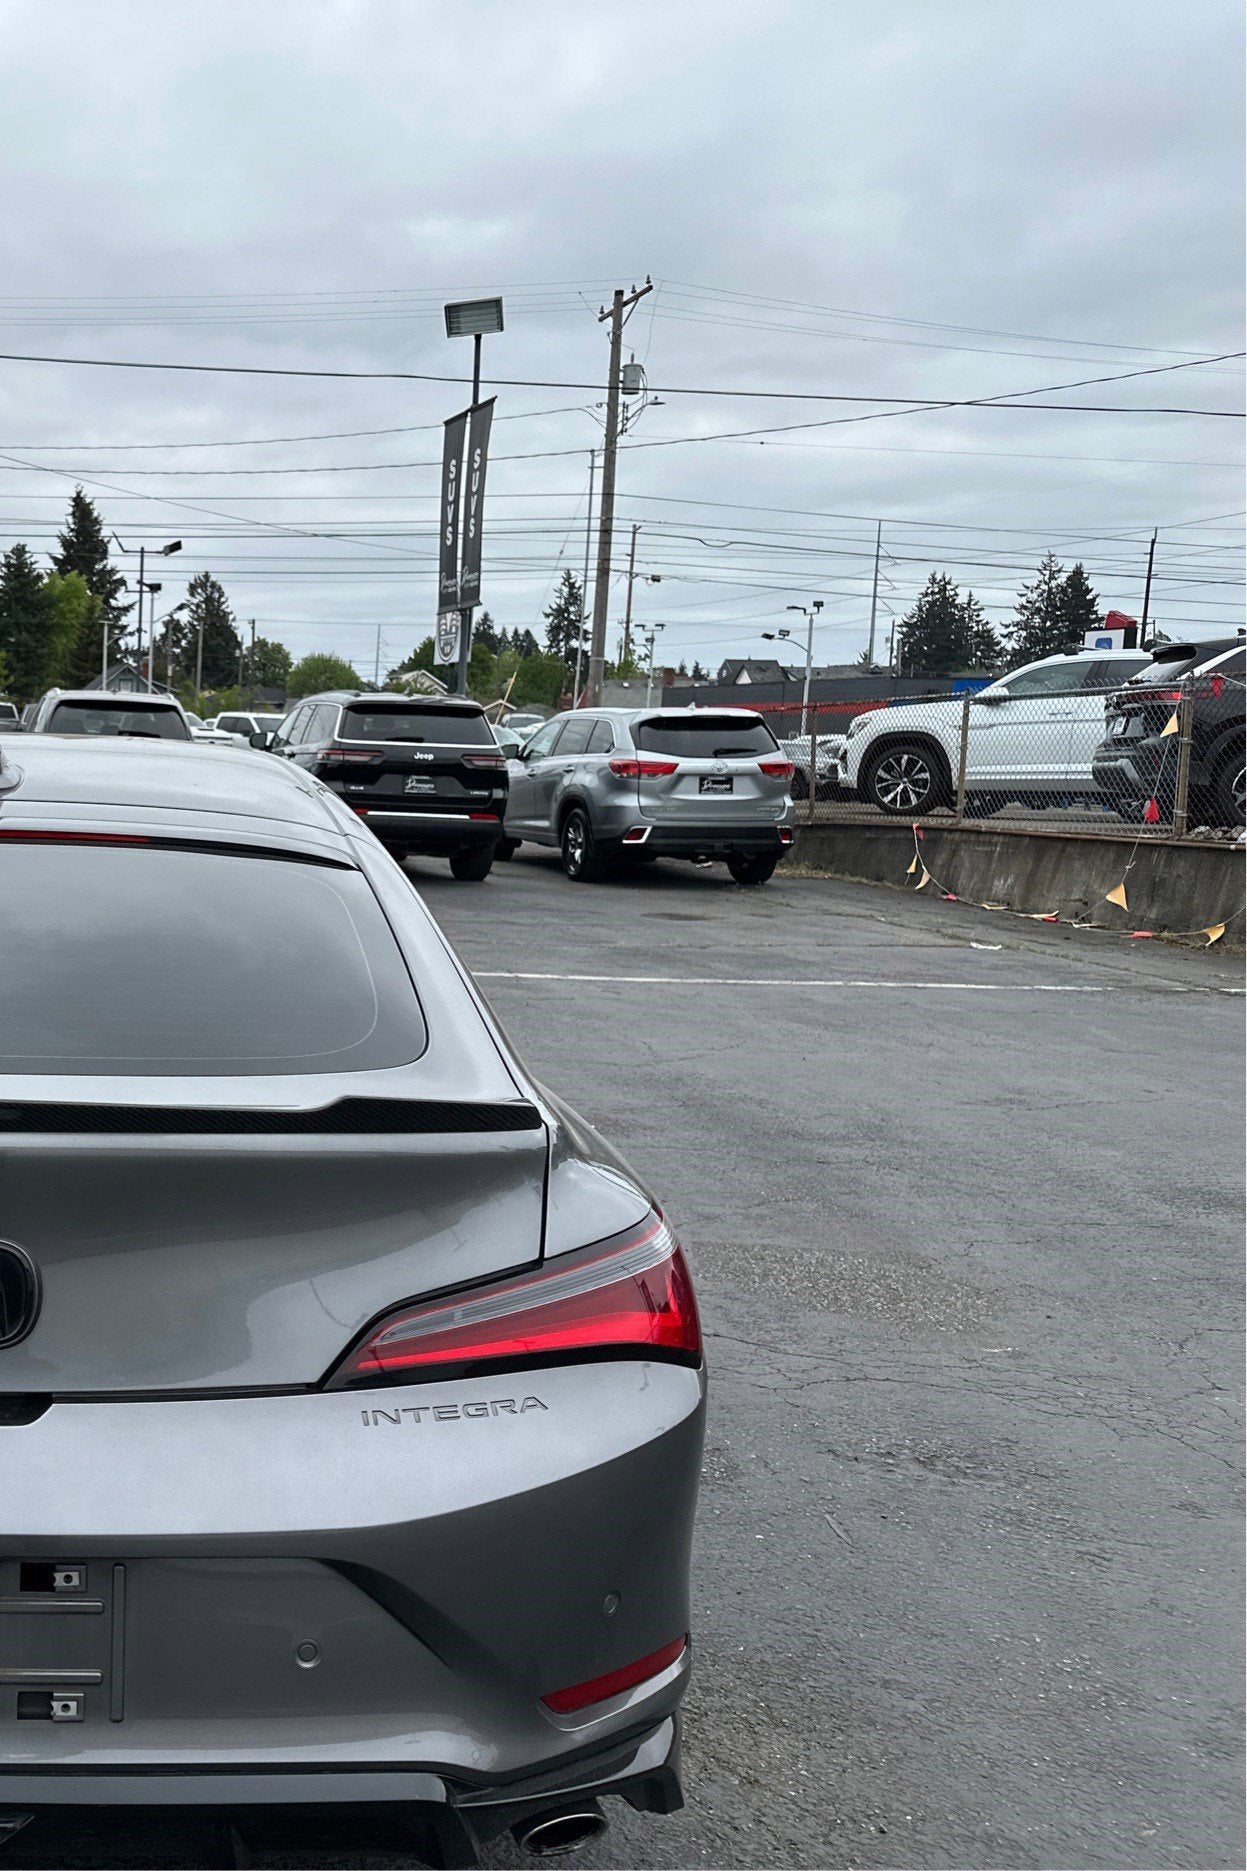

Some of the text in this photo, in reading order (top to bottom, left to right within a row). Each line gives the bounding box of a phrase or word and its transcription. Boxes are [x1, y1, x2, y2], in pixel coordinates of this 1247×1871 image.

[445, 459, 457, 546] SUVS
[468, 448, 482, 539] SUVS
[413, 751, 434, 761] Jeep
[361, 1396, 548, 1426] INTEGRA
